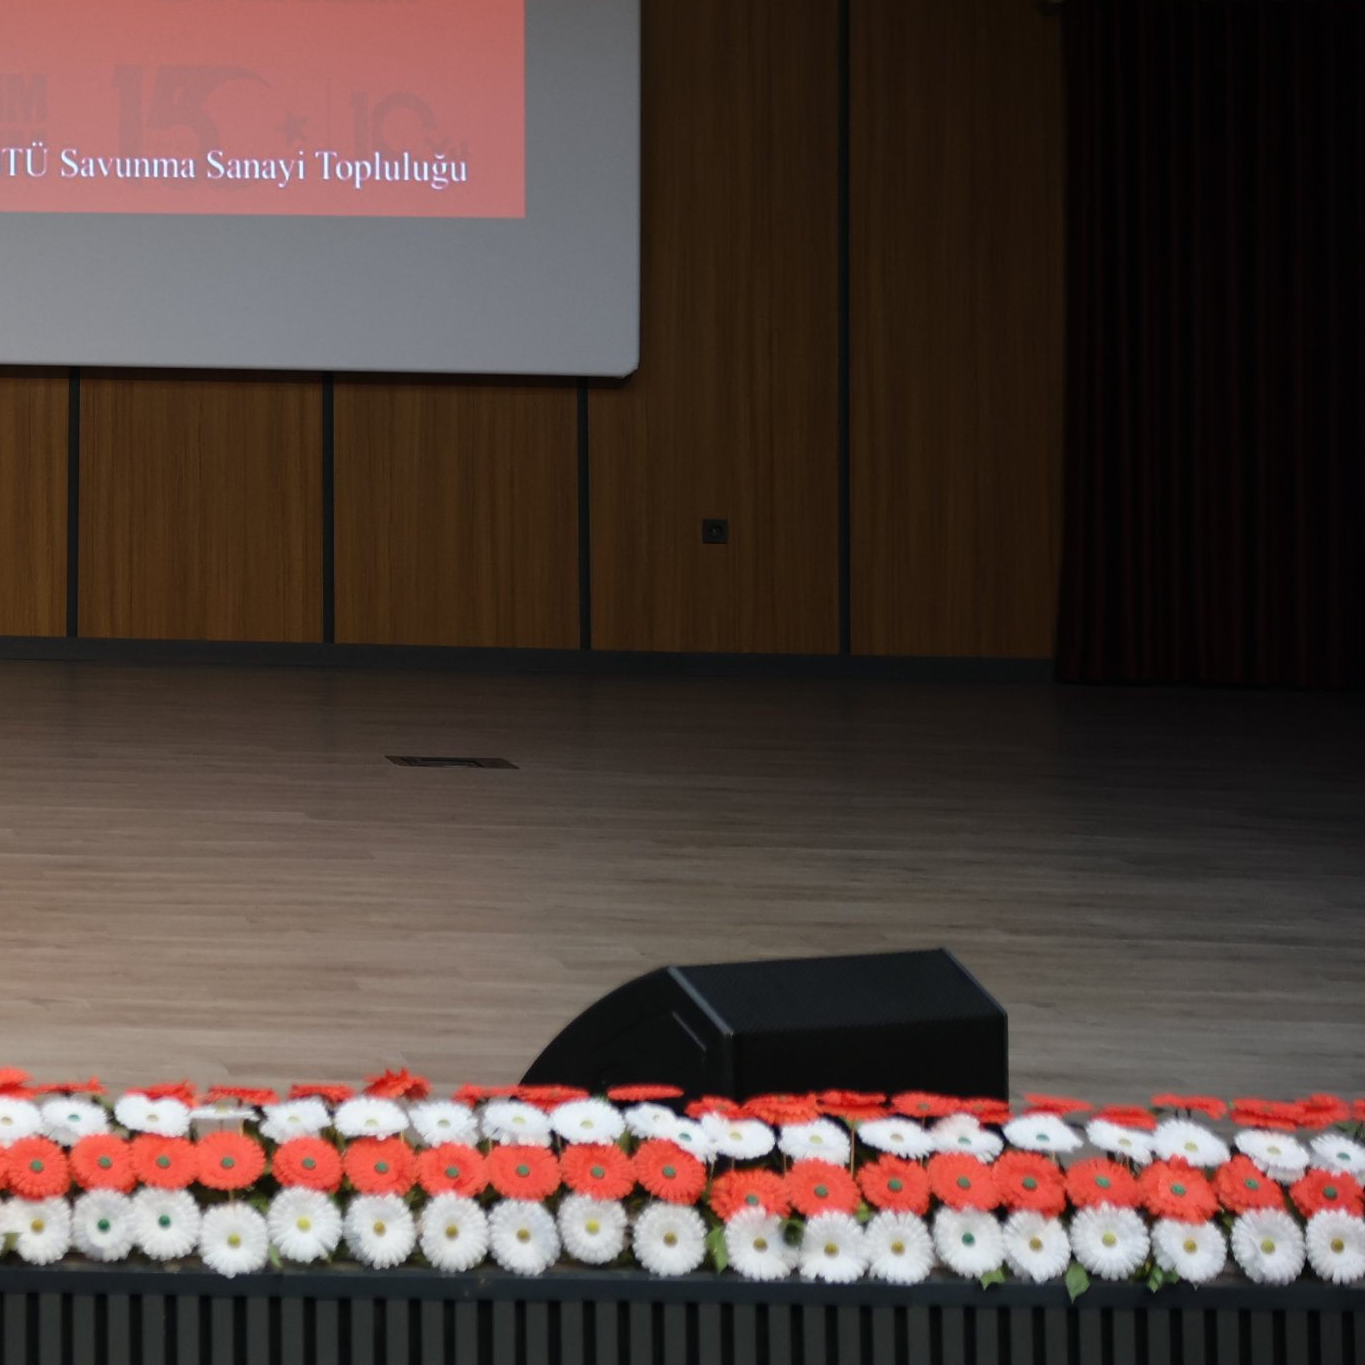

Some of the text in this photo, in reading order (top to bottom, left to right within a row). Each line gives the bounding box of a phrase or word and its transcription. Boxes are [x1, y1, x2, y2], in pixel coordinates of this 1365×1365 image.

[60, 149, 195, 179] Savunma
[207, 151, 305, 188] Sanayi
[315, 151, 468, 190] Topluluğu
